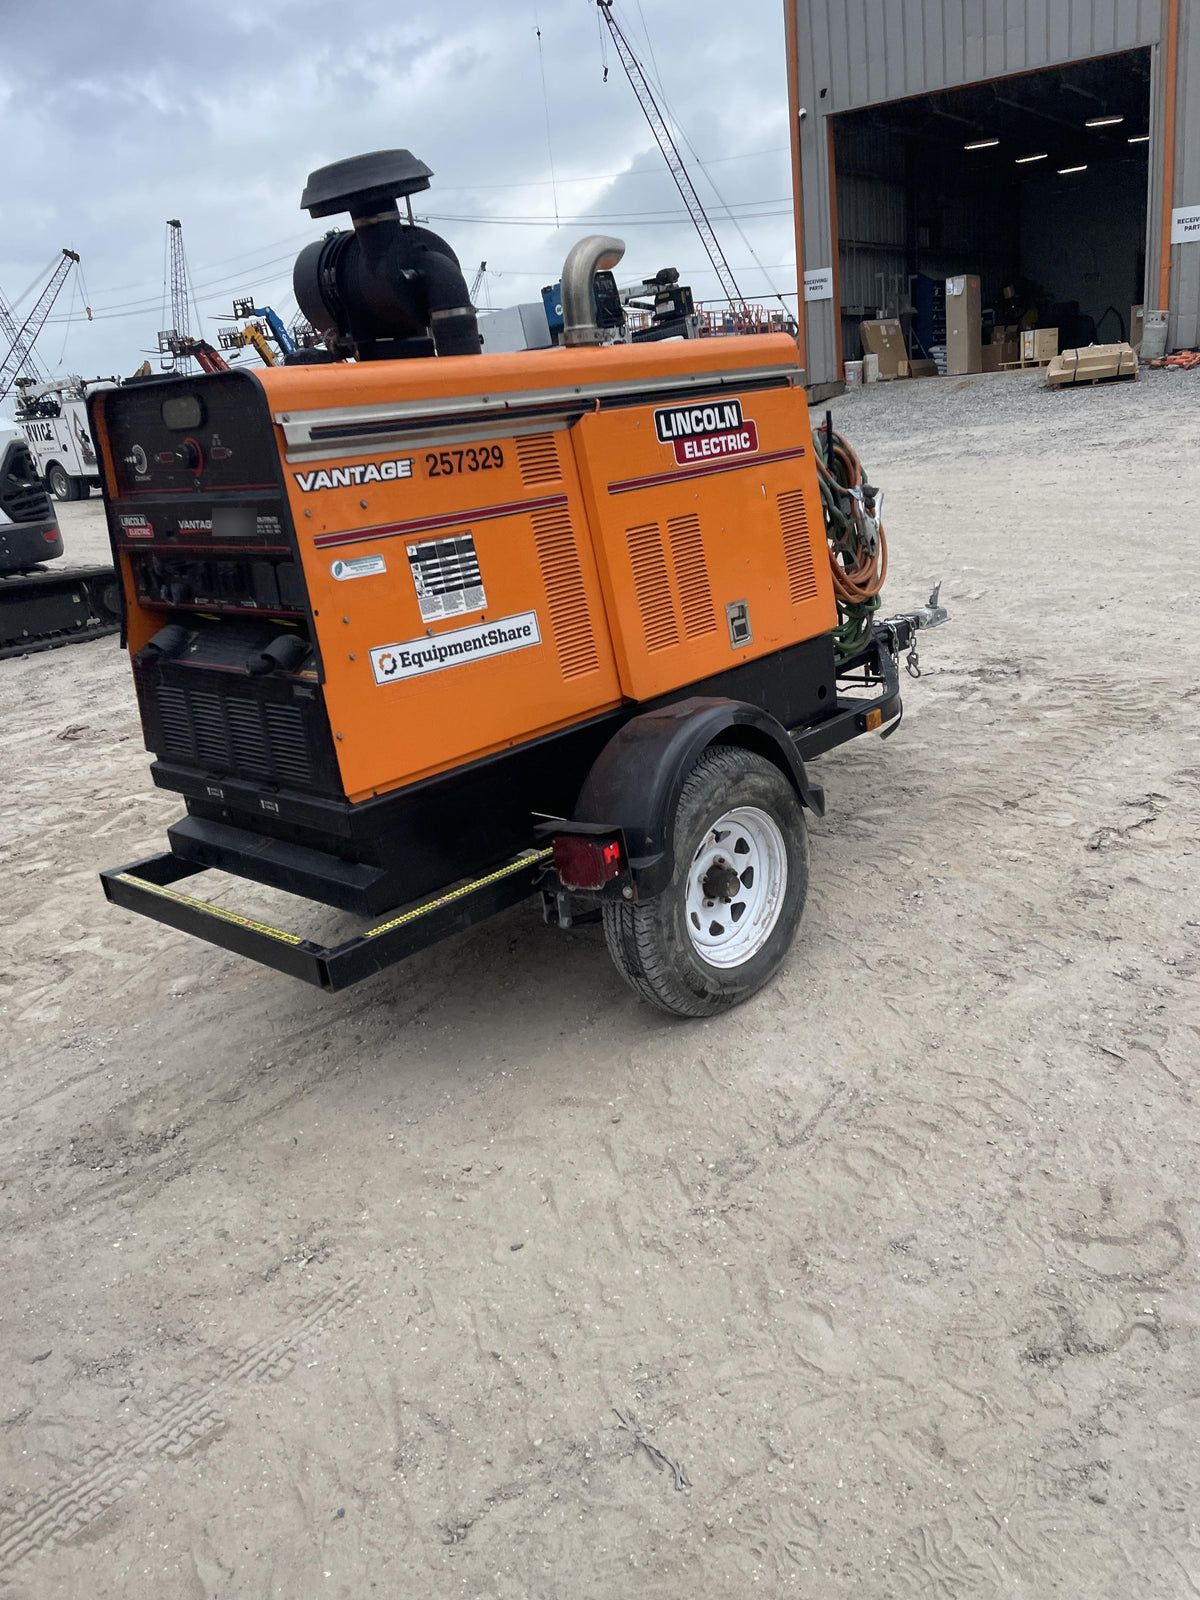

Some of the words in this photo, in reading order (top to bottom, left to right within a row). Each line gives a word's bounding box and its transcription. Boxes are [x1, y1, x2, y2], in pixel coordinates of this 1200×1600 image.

[659, 404, 740, 438] LINCOLN
[425, 445, 505, 477] 257329
[683, 431, 751, 459] ELECTRIC
[294, 459, 413, 492] VANTAGE
[121, 516, 146, 527] LINCOLN
[178, 519, 212, 529] VANTAG
[399, 624, 532, 668] EquipmentShare
